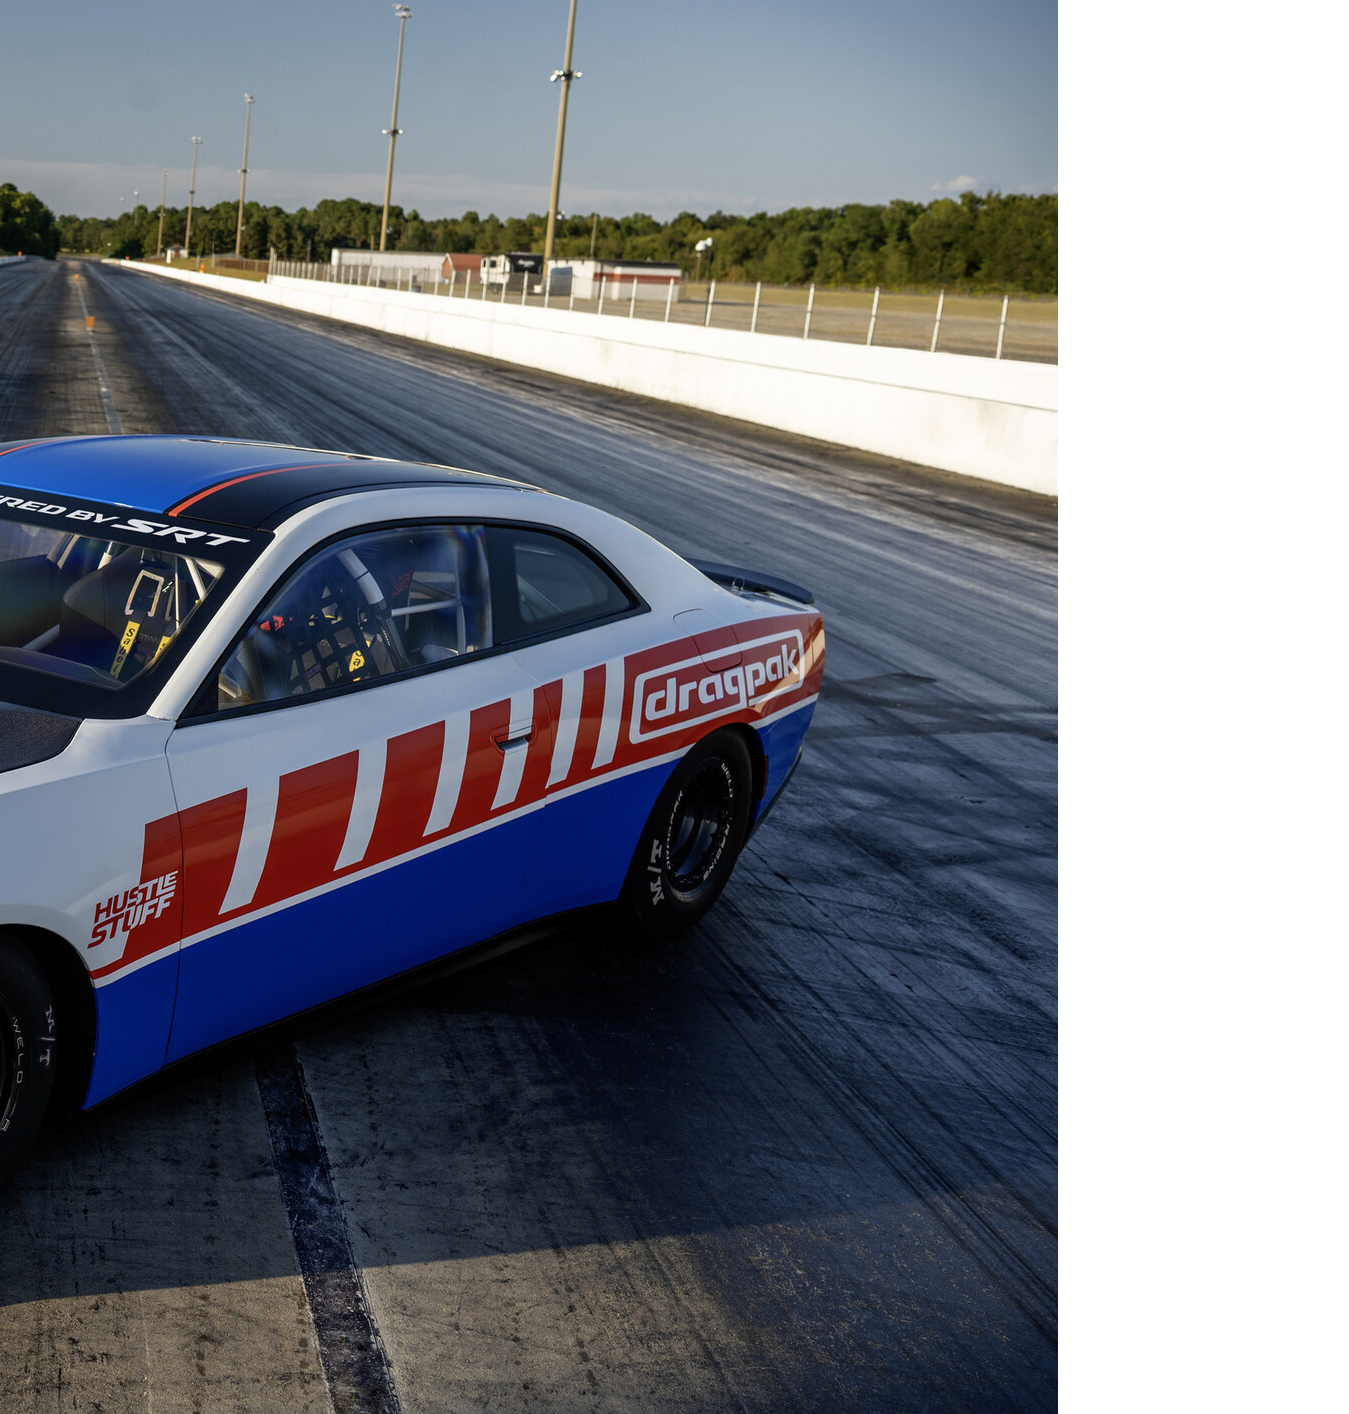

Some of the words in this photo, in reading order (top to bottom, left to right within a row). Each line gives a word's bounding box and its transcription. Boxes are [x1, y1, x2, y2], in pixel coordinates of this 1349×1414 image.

[65, 509, 119, 524] BY
[111, 518, 251, 546] SRT
[645, 644, 800, 721] dragpak
[93, 870, 179, 924] HUSTLE
[646, 838, 665, 906] M/T
[87, 891, 175, 949] STUFF
[11, 1016, 24, 1084] WELD
